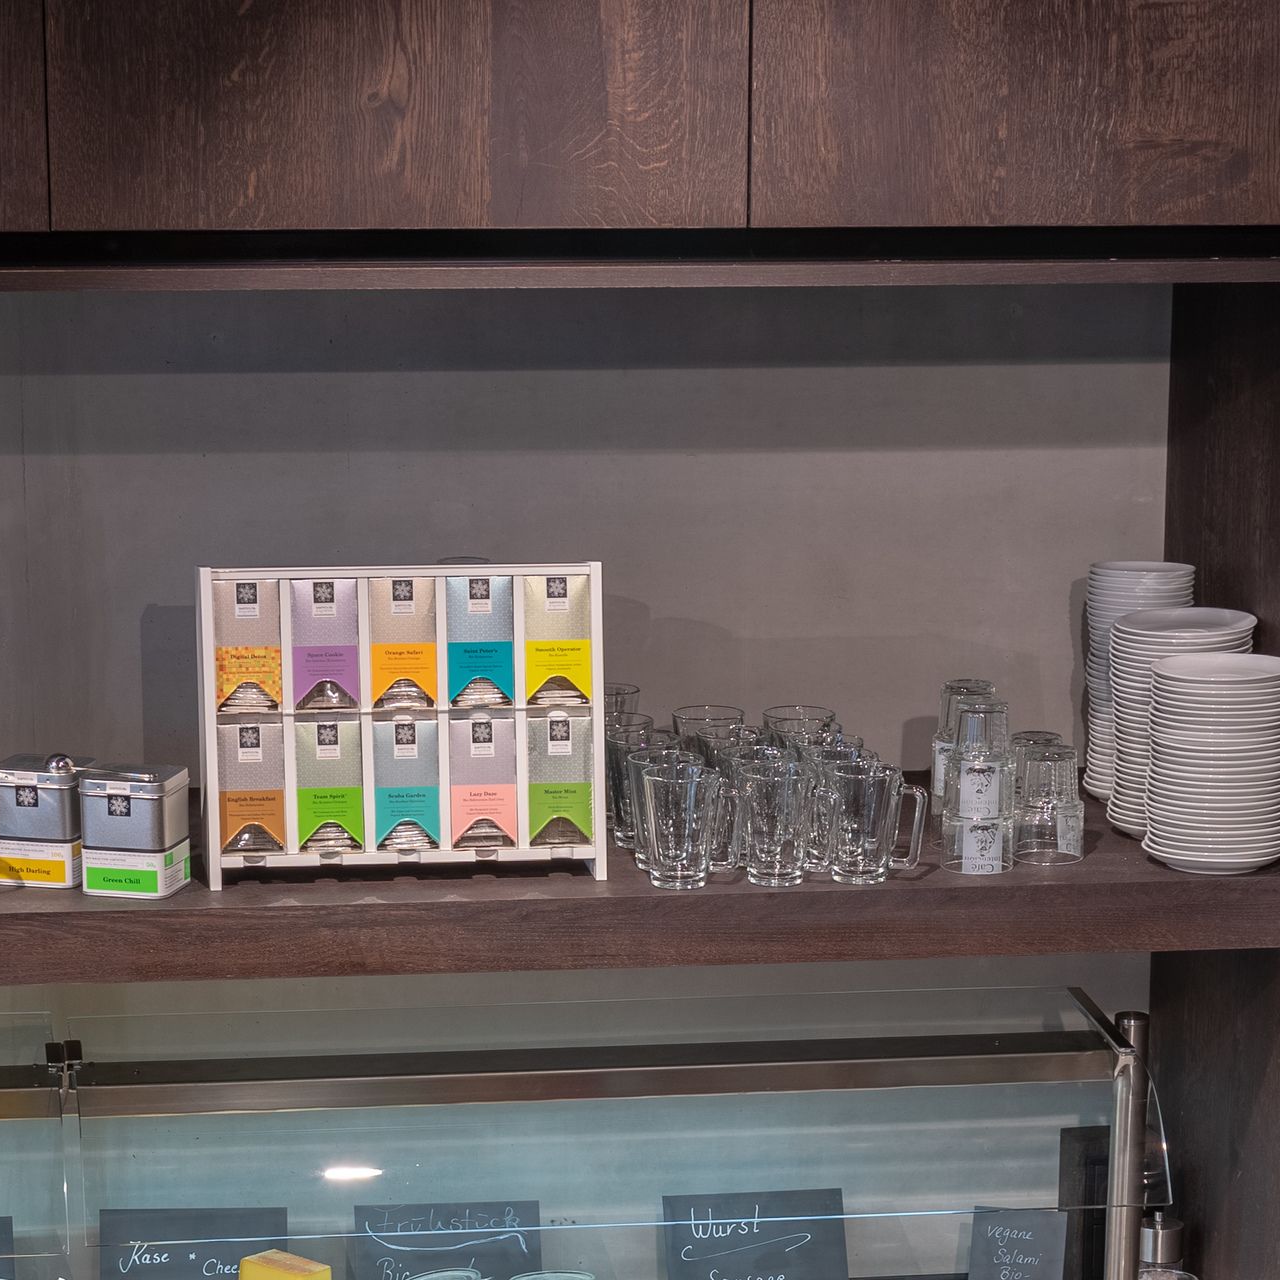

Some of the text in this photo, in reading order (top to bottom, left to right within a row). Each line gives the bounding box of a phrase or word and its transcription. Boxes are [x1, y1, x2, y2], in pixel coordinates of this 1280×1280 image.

[8, 865, 52, 876] High Darling
[971, 863, 995, 874] Café
[102, 876, 141, 885] Green Chill
[690, 1204, 761, 1239] Wurst
[993, 1247, 1043, 1266] Salami
[202, 1259, 242, 1277] Chee
